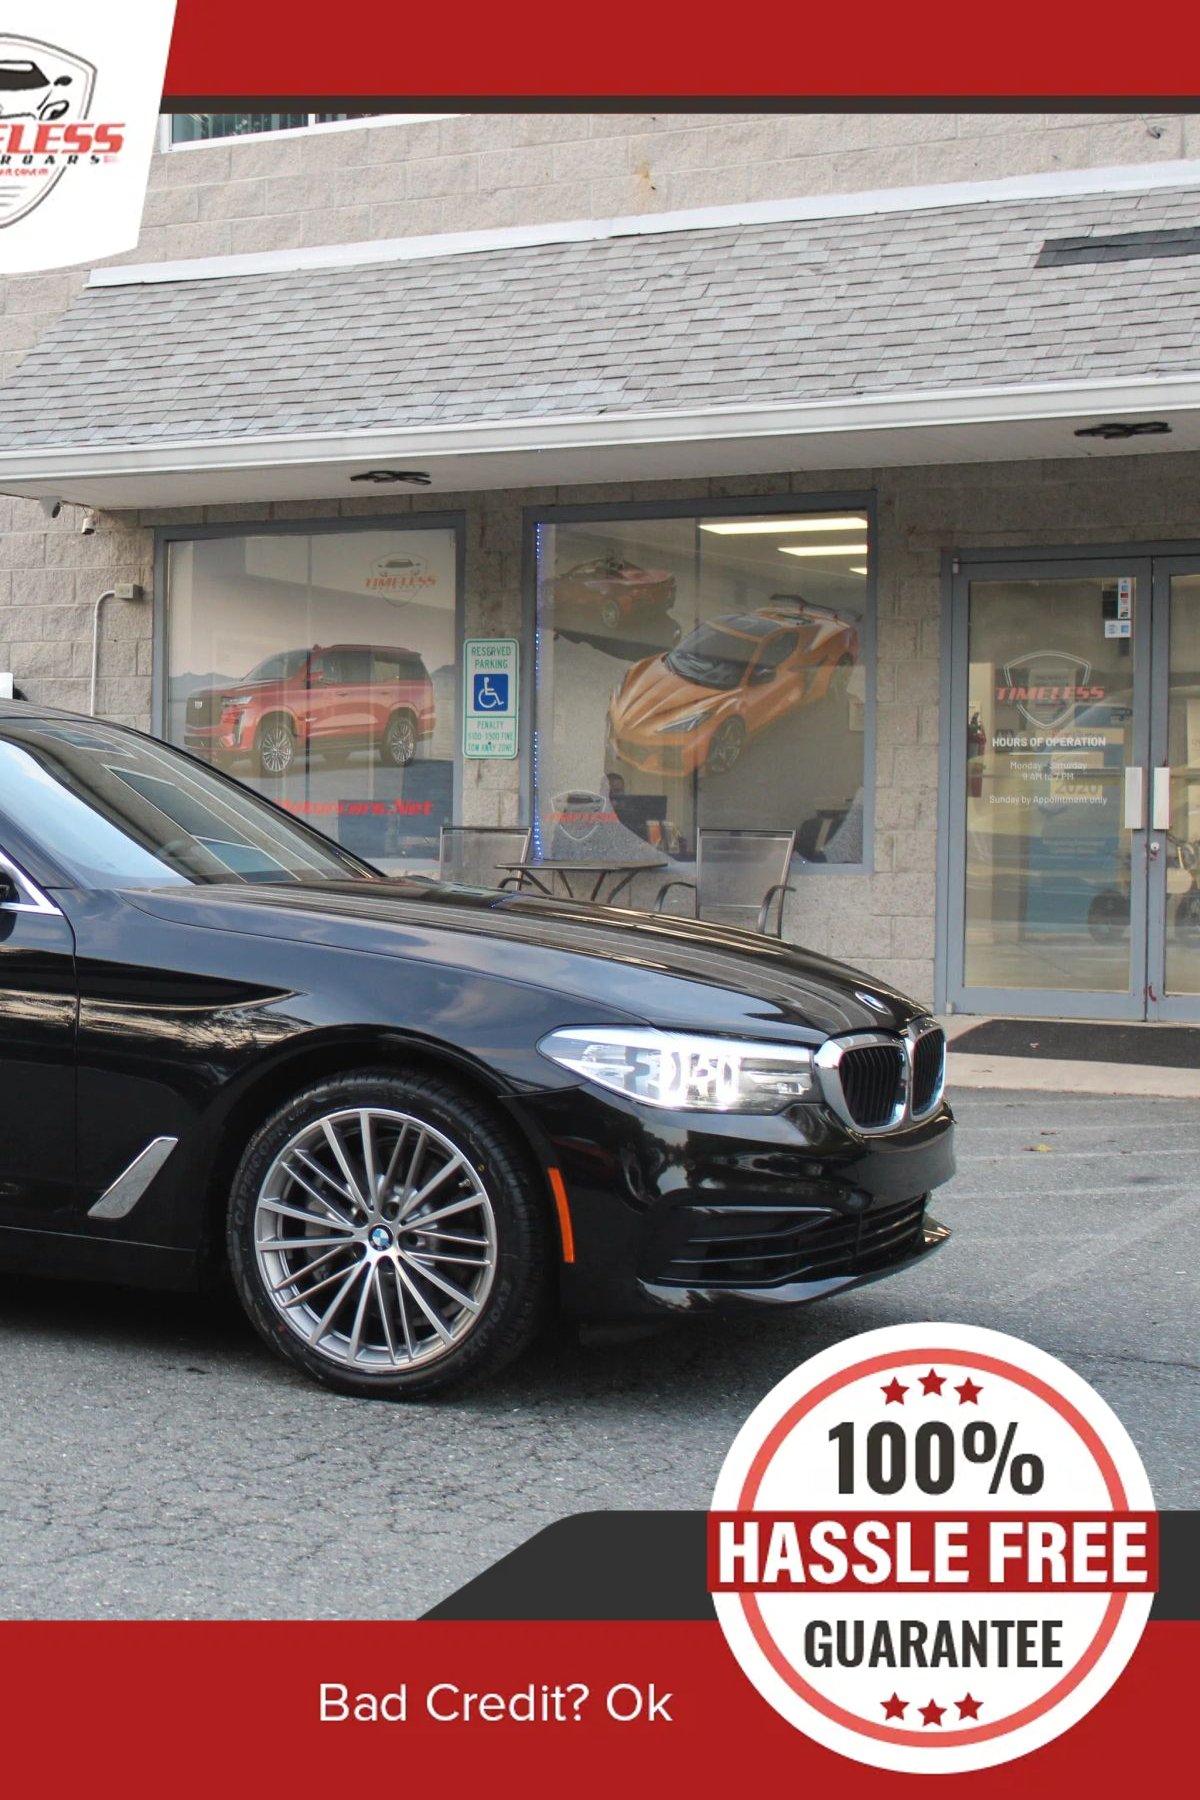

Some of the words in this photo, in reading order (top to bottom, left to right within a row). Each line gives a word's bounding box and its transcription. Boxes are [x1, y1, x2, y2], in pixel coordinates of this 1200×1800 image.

[471, 646, 511, 657] RESERVED
[475, 659, 508, 669] PARKING
[995, 685, 1105, 701] TIMELESS
[477, 720, 504, 729] PENALTY
[992, 737, 1028, 748] HOURS
[1029, 737, 1043, 747] OF
[1045, 736, 1106, 747] OPERATION
[1010, 761, 1042, 772] Monday
[989, 795, 1020, 806] Sunday
[1021, 795, 1031, 806] by
[1033, 794, 1088, 806] Appointment
